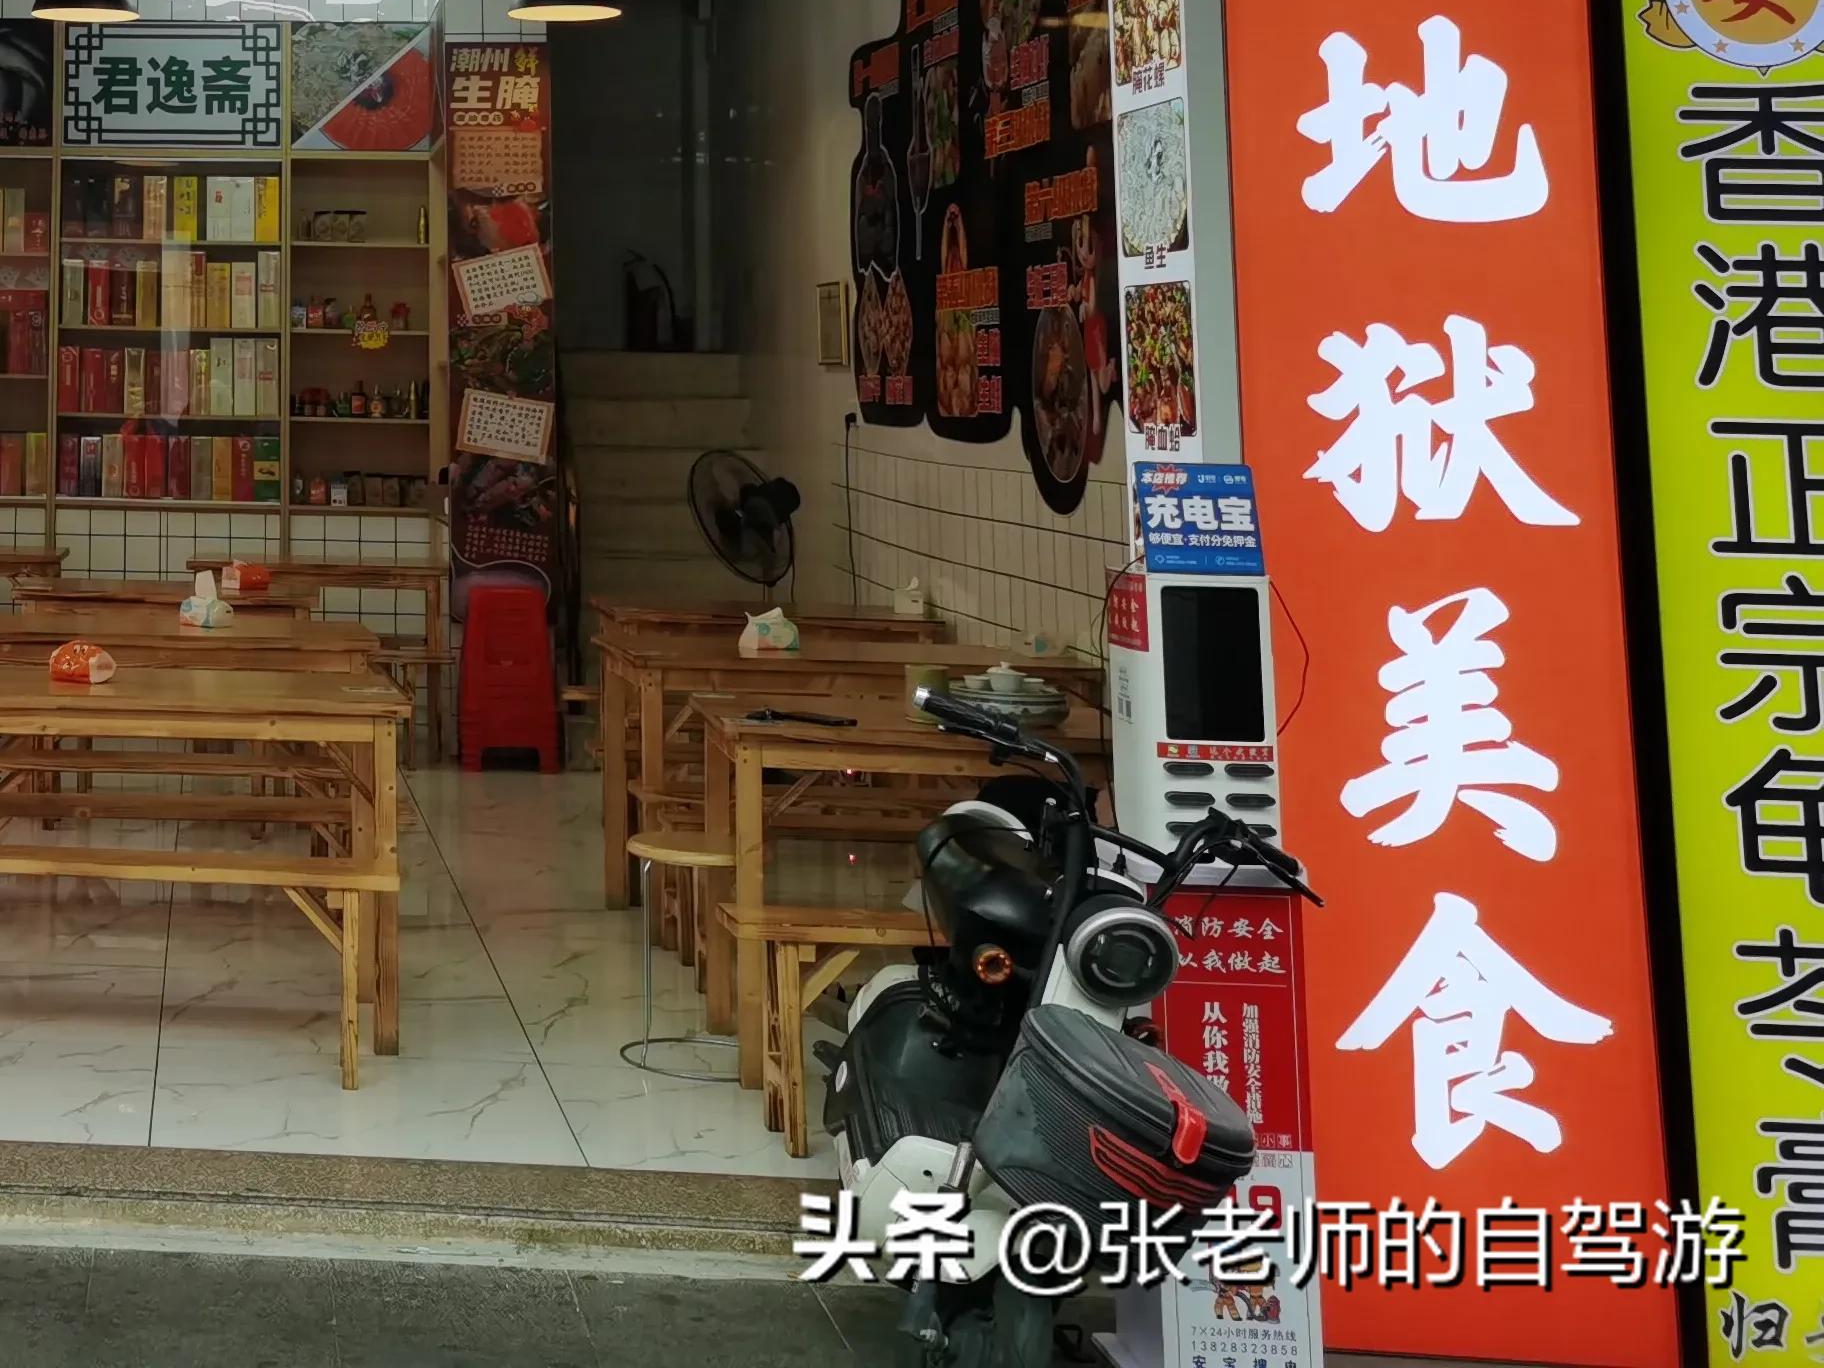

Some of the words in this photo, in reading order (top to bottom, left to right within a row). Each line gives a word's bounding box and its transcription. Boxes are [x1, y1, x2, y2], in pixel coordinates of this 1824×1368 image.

[450, 48, 510, 72] 潮州
[92, 56, 252, 116] 君逸斋
[450, 75, 540, 110] 生腌
[1144, 243, 1167, 270] 鱼生
[1144, 495, 1255, 531] 充电宝
[1297, 16, 1613, 1169] 地狱美食
